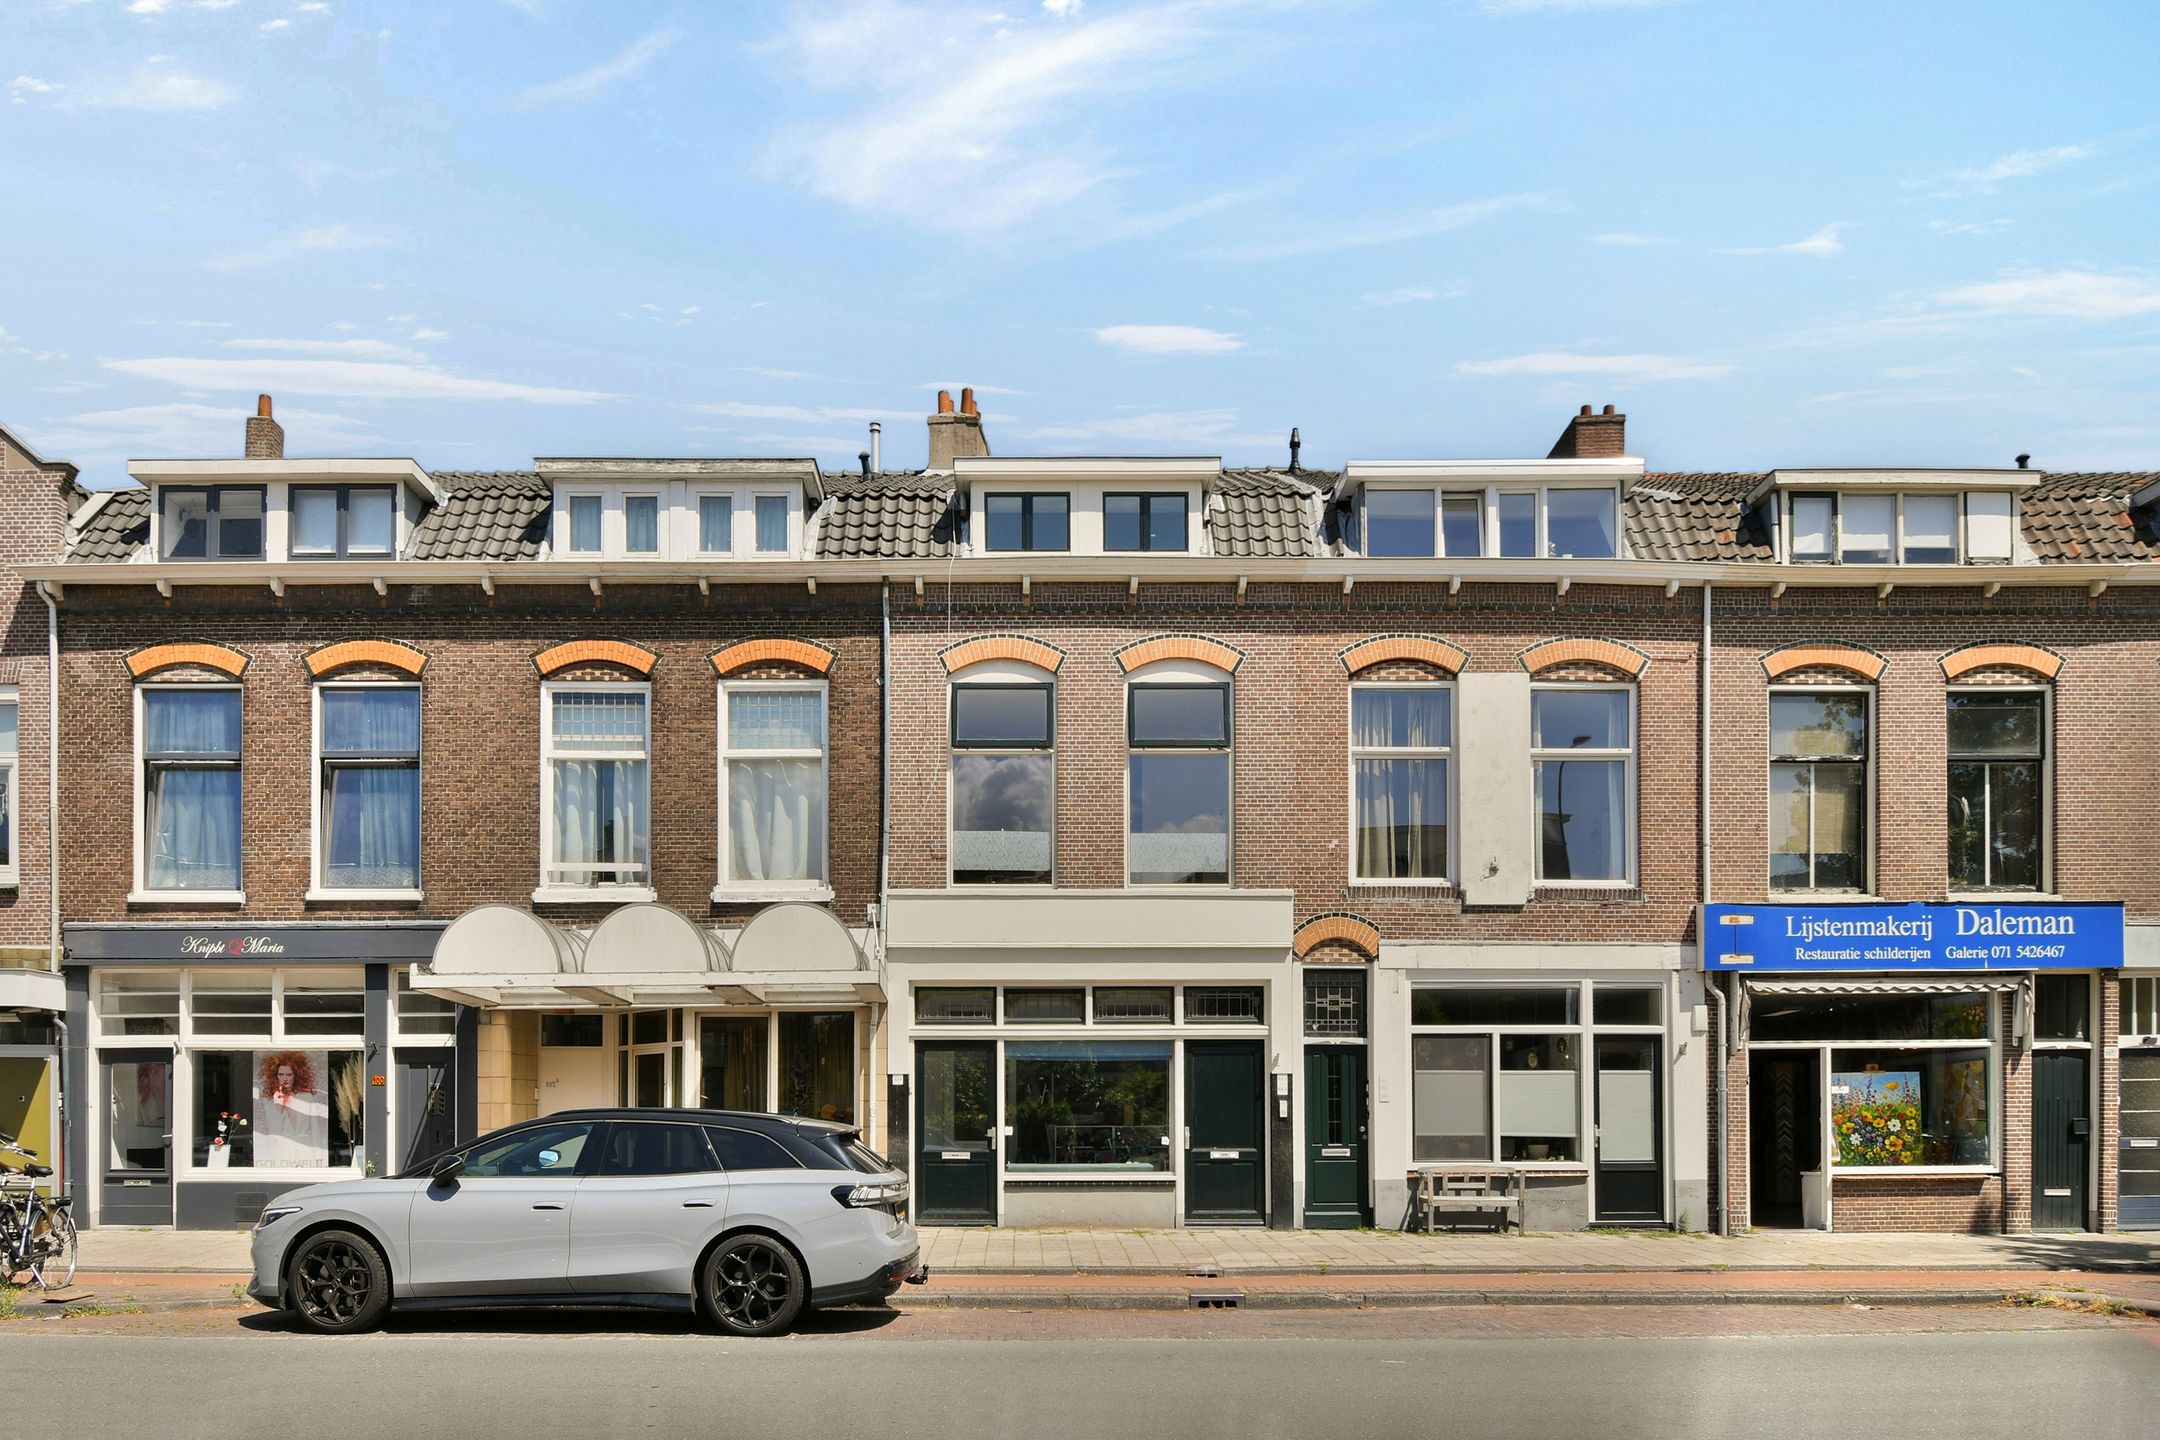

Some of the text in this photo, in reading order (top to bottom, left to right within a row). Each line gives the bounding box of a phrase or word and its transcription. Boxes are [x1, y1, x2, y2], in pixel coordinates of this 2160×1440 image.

[1785, 909, 2074, 942] Lijstenmakerij Daleman
[240, 935, 285, 954] Maria
[1796, 946, 2064, 961] Restauratie schilderijen Galerie 071 5426467
